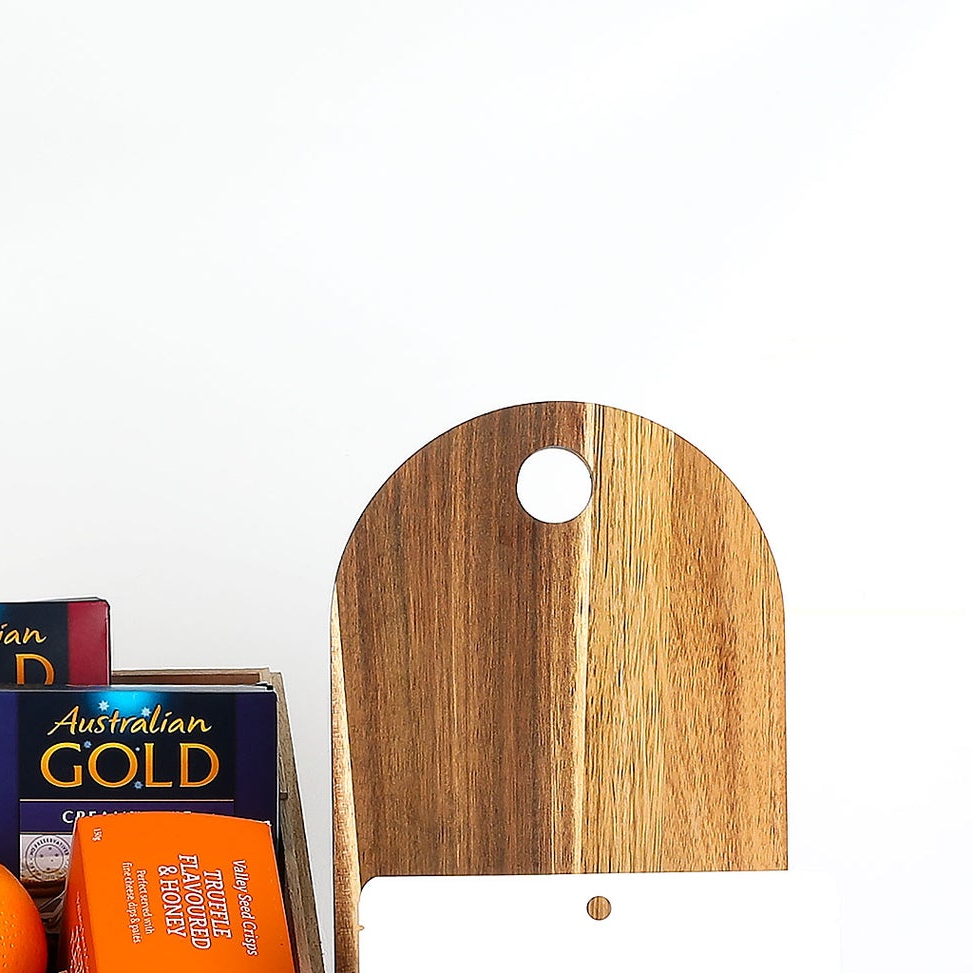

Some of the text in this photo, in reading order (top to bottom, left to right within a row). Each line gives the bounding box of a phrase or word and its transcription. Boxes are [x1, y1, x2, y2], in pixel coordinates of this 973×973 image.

[47, 705, 212, 735] Australian
[40, 742, 220, 788] GOLD
[136, 869, 155, 934] Perfect served with
[157, 865, 187, 937] & HONEY
[178, 854, 211, 949] FLAVOURED
[203, 869, 232, 938] TRUFFLE
[232, 859, 259, 956] Valley Seed Crisps
